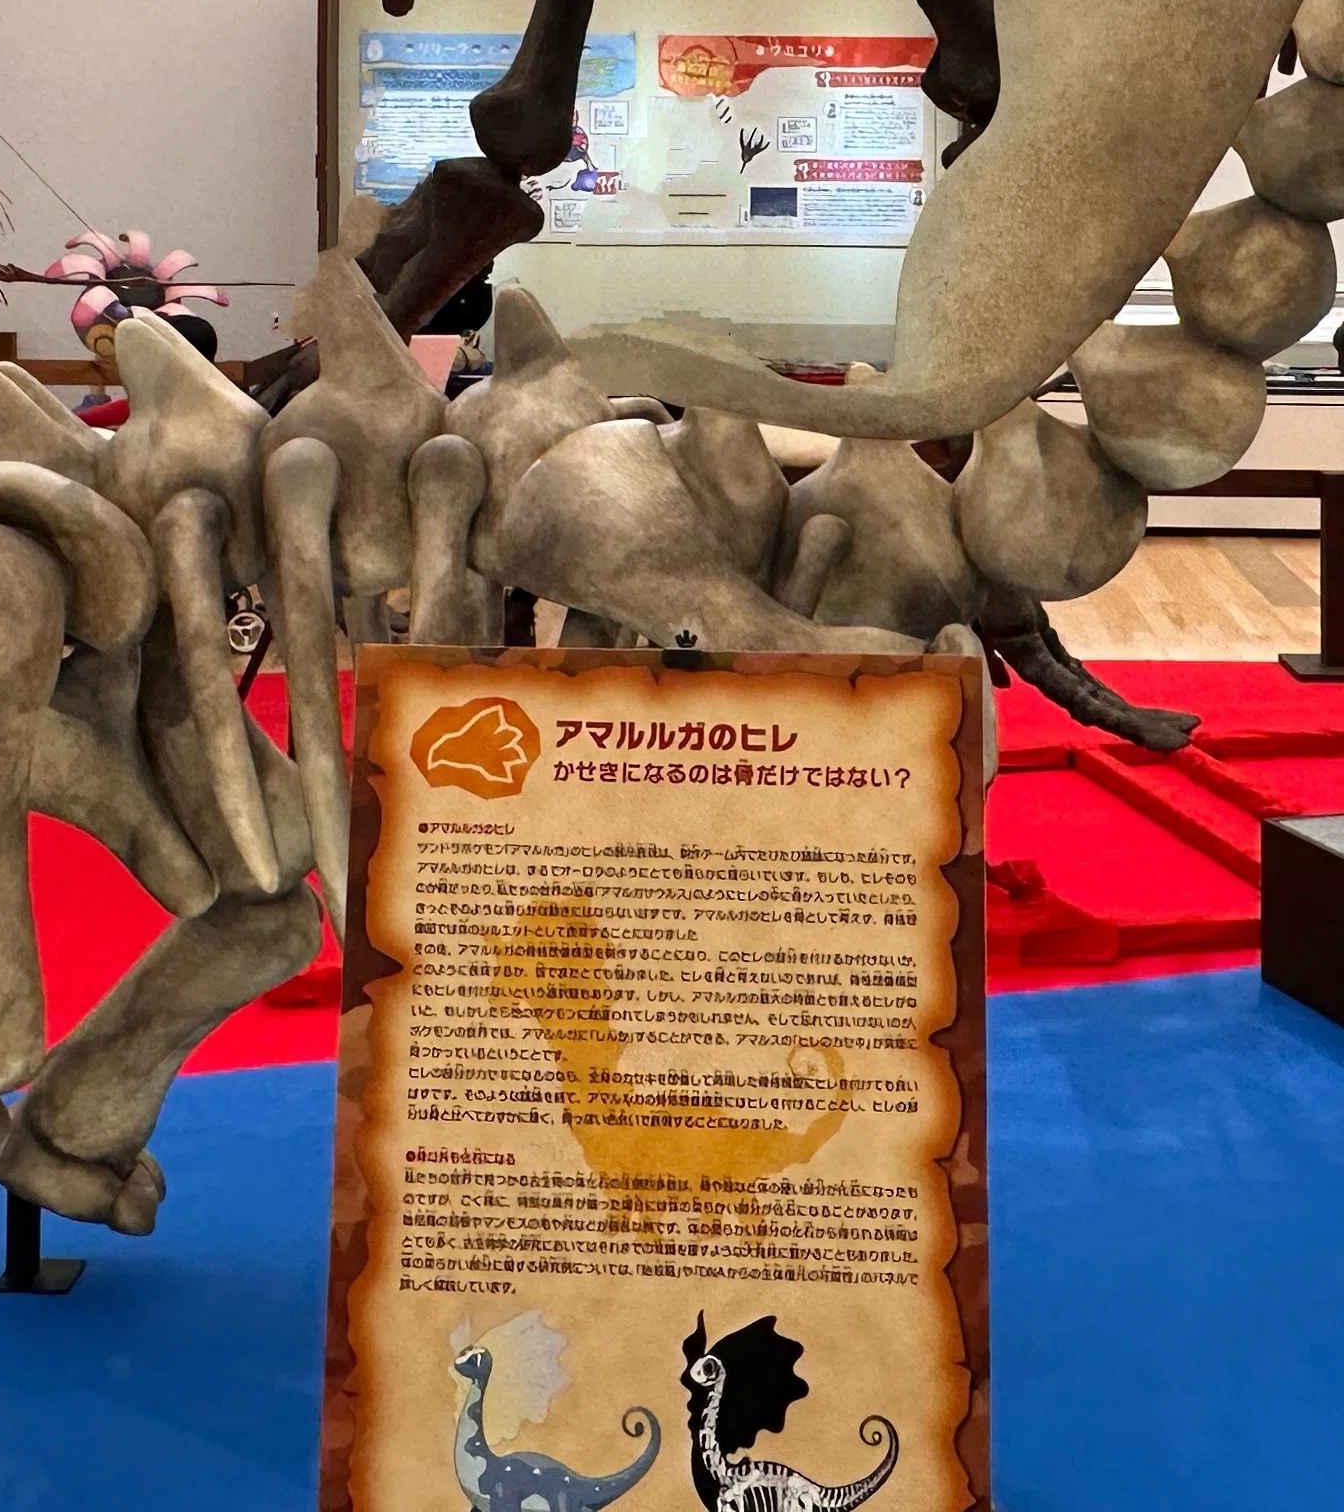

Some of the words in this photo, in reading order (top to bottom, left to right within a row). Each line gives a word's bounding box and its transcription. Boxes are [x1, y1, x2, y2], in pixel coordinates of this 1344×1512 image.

[556, 720, 798, 752] アマルルガのヒレ
